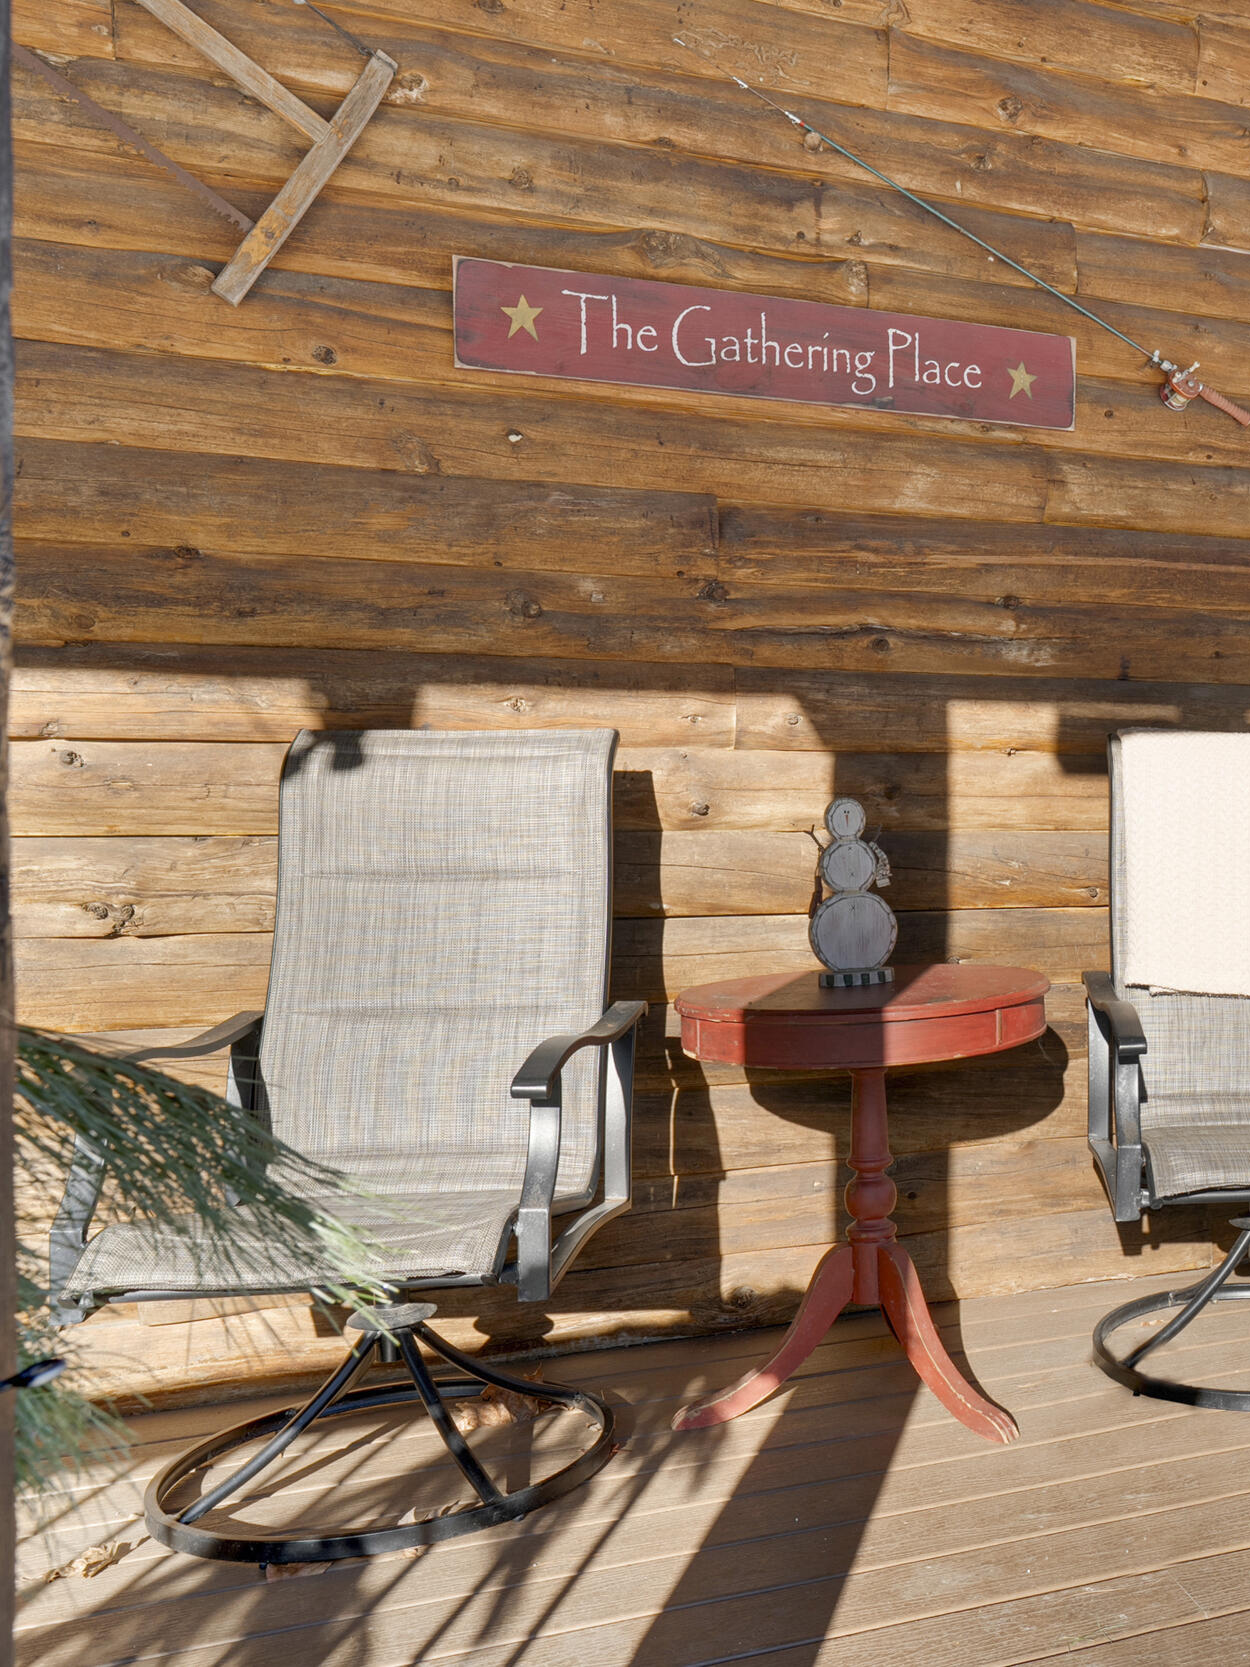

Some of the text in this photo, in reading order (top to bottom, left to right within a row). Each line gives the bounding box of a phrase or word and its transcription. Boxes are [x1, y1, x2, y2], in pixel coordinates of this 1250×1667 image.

[561, 289, 983, 396] The Gathering Place
